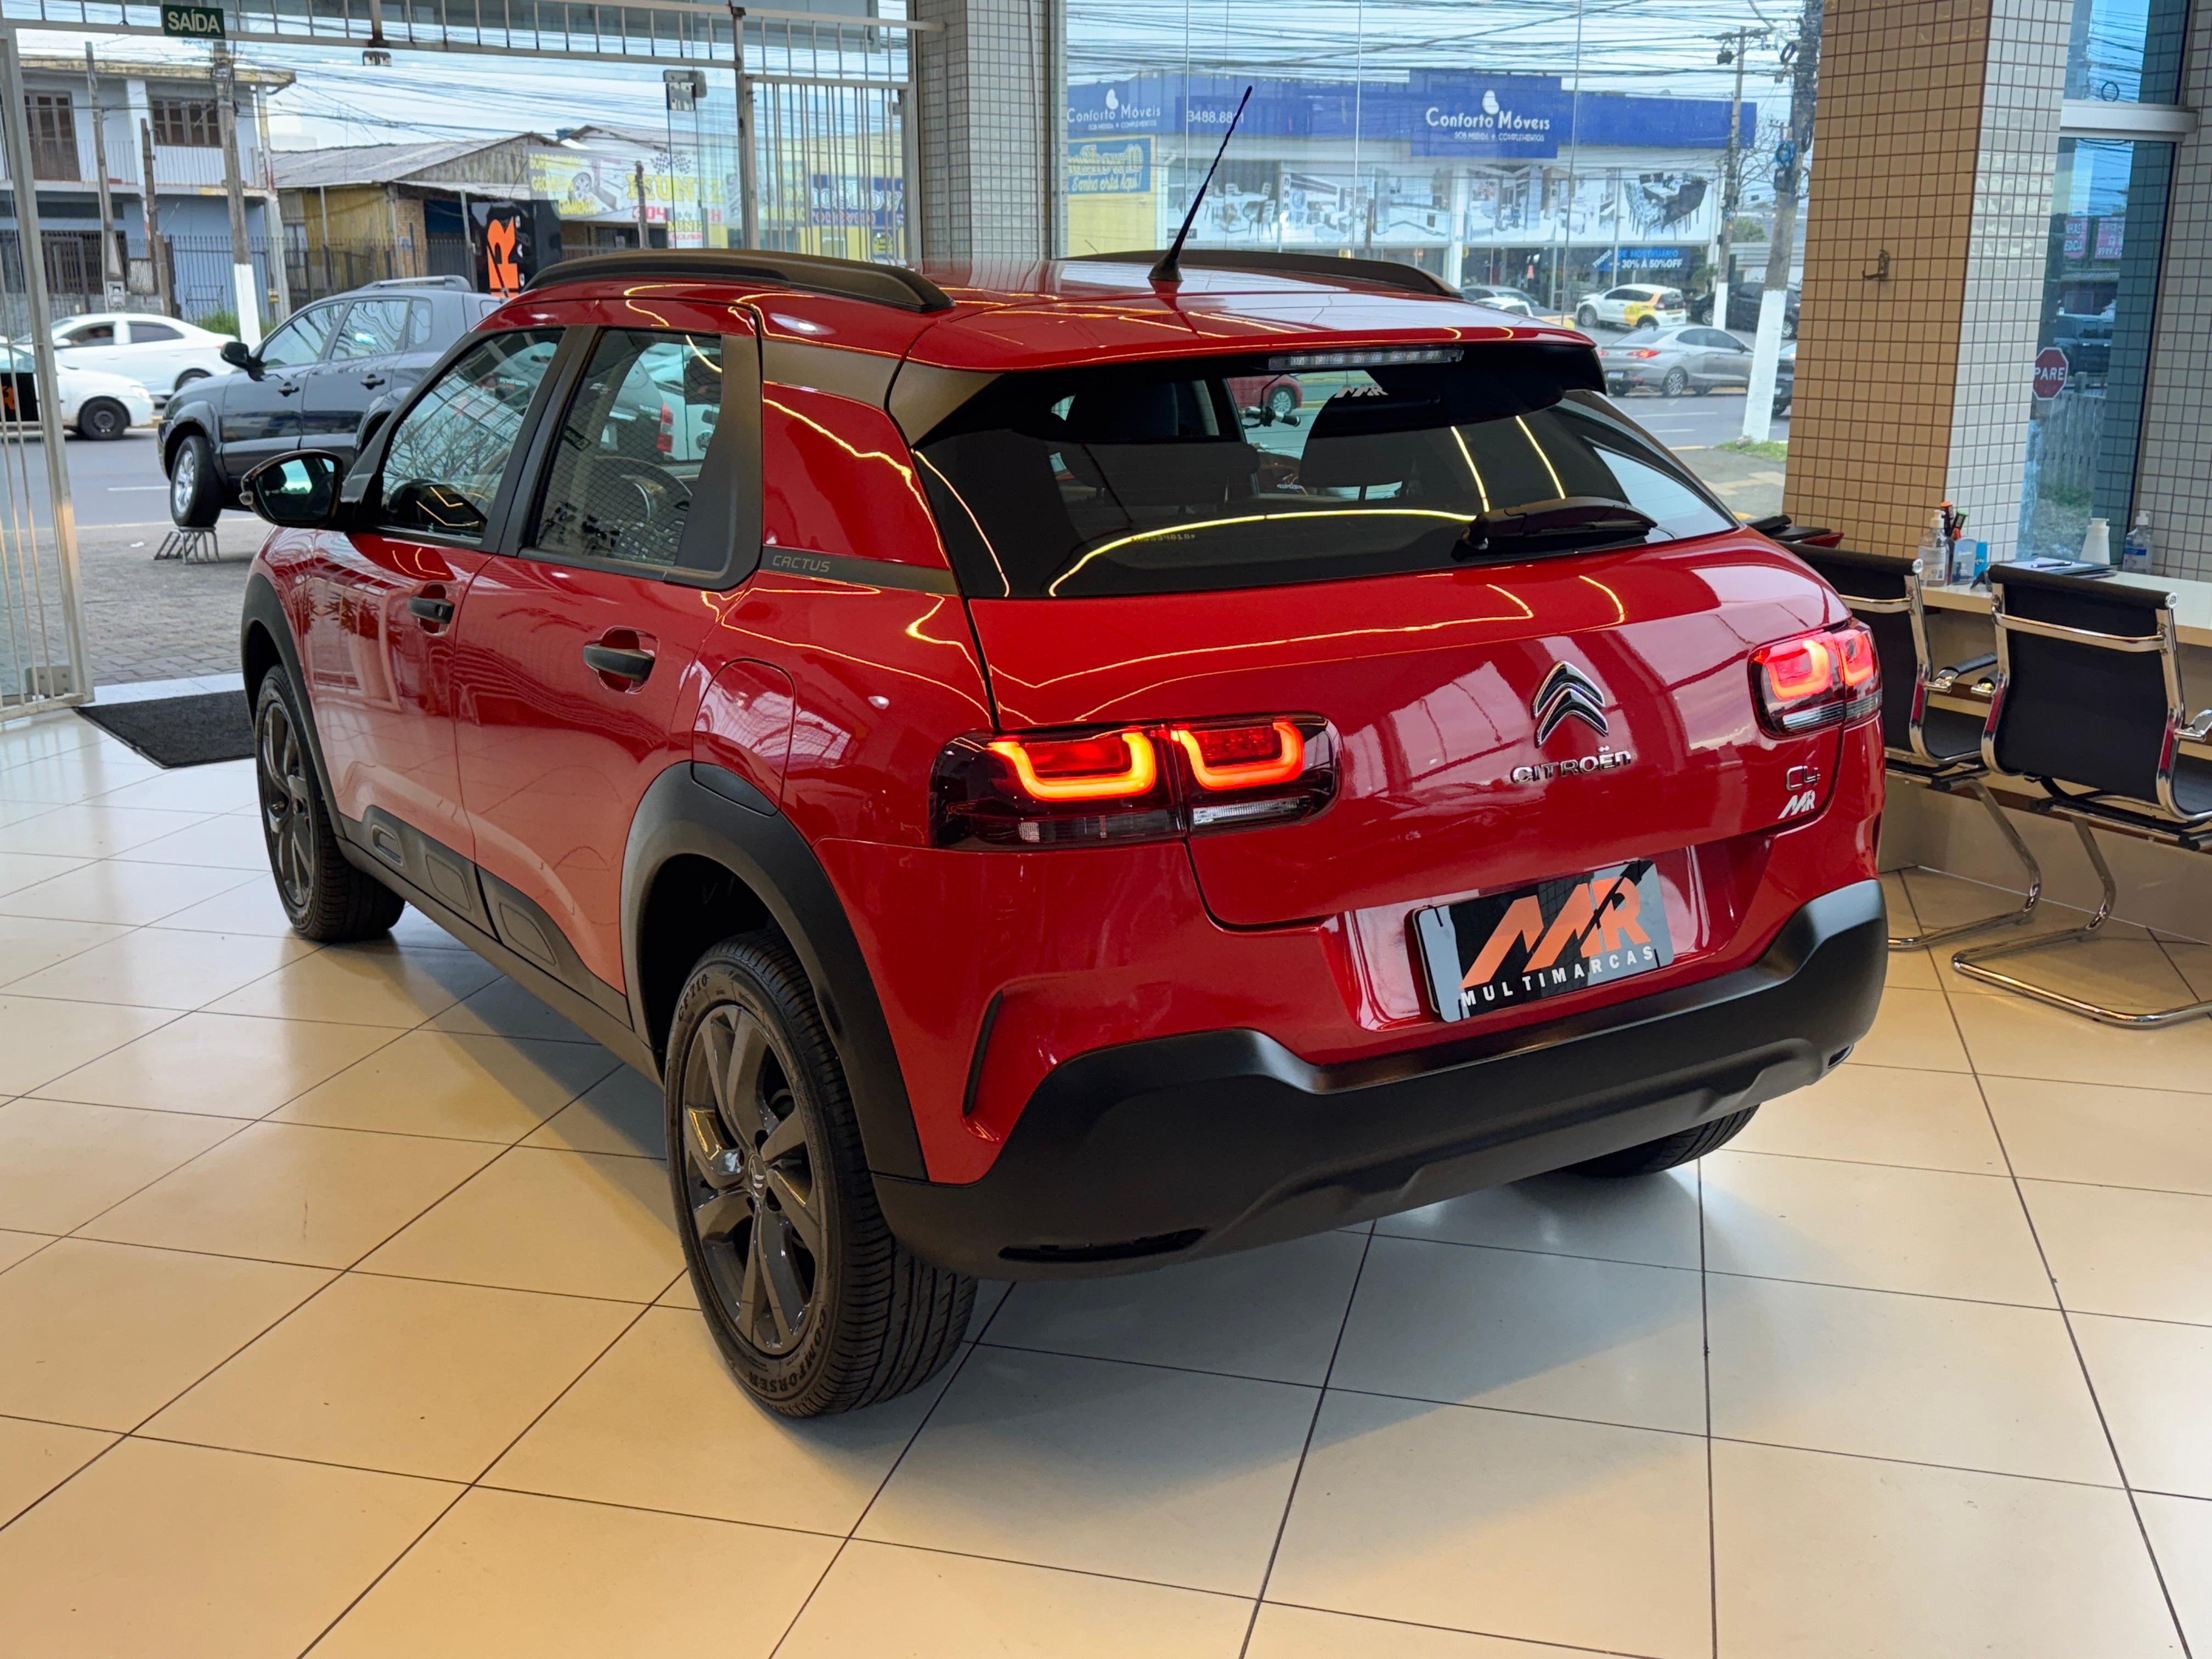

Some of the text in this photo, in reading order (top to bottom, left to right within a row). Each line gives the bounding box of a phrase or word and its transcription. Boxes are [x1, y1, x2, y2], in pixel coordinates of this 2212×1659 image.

[167, 8, 221, 33] SAÍDA
[1067, 103, 1161, 123] Conforto Móveis
[1188, 110, 1244, 123] 3488.881
[1425, 107, 1550, 131] Conforto Móveis
[1621, 259, 1640, 269] 30%
[2034, 366, 2066, 381] PARE
[772, 555, 831, 573] CACTUS
[1510, 745, 1632, 784] CITROËN
[1786, 765, 1821, 791] C4
[1460, 945, 1654, 1007] MULTIMARCAS
